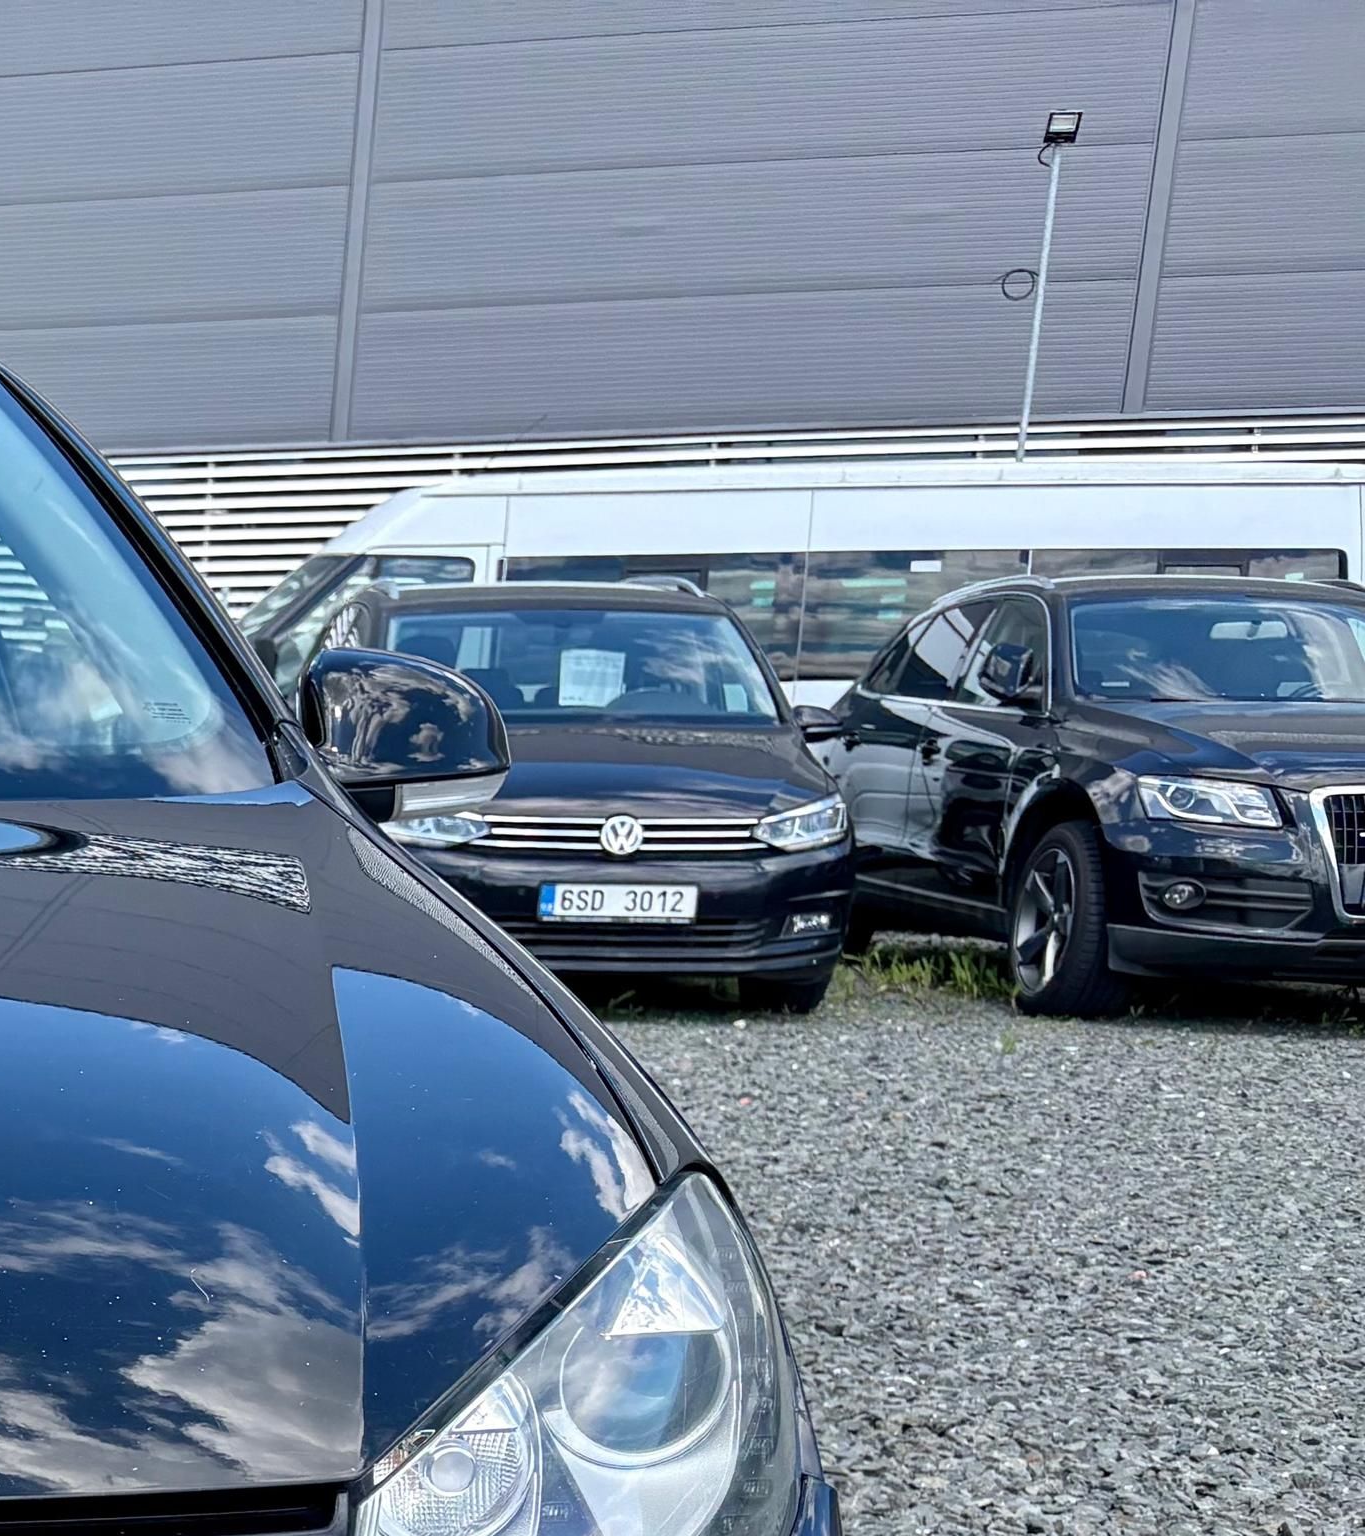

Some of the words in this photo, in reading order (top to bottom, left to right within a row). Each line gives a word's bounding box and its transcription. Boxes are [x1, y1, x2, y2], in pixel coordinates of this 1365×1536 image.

[603, 816, 641, 854] VW
[560, 889, 605, 911] 6SD
[624, 890, 684, 913] 3012
